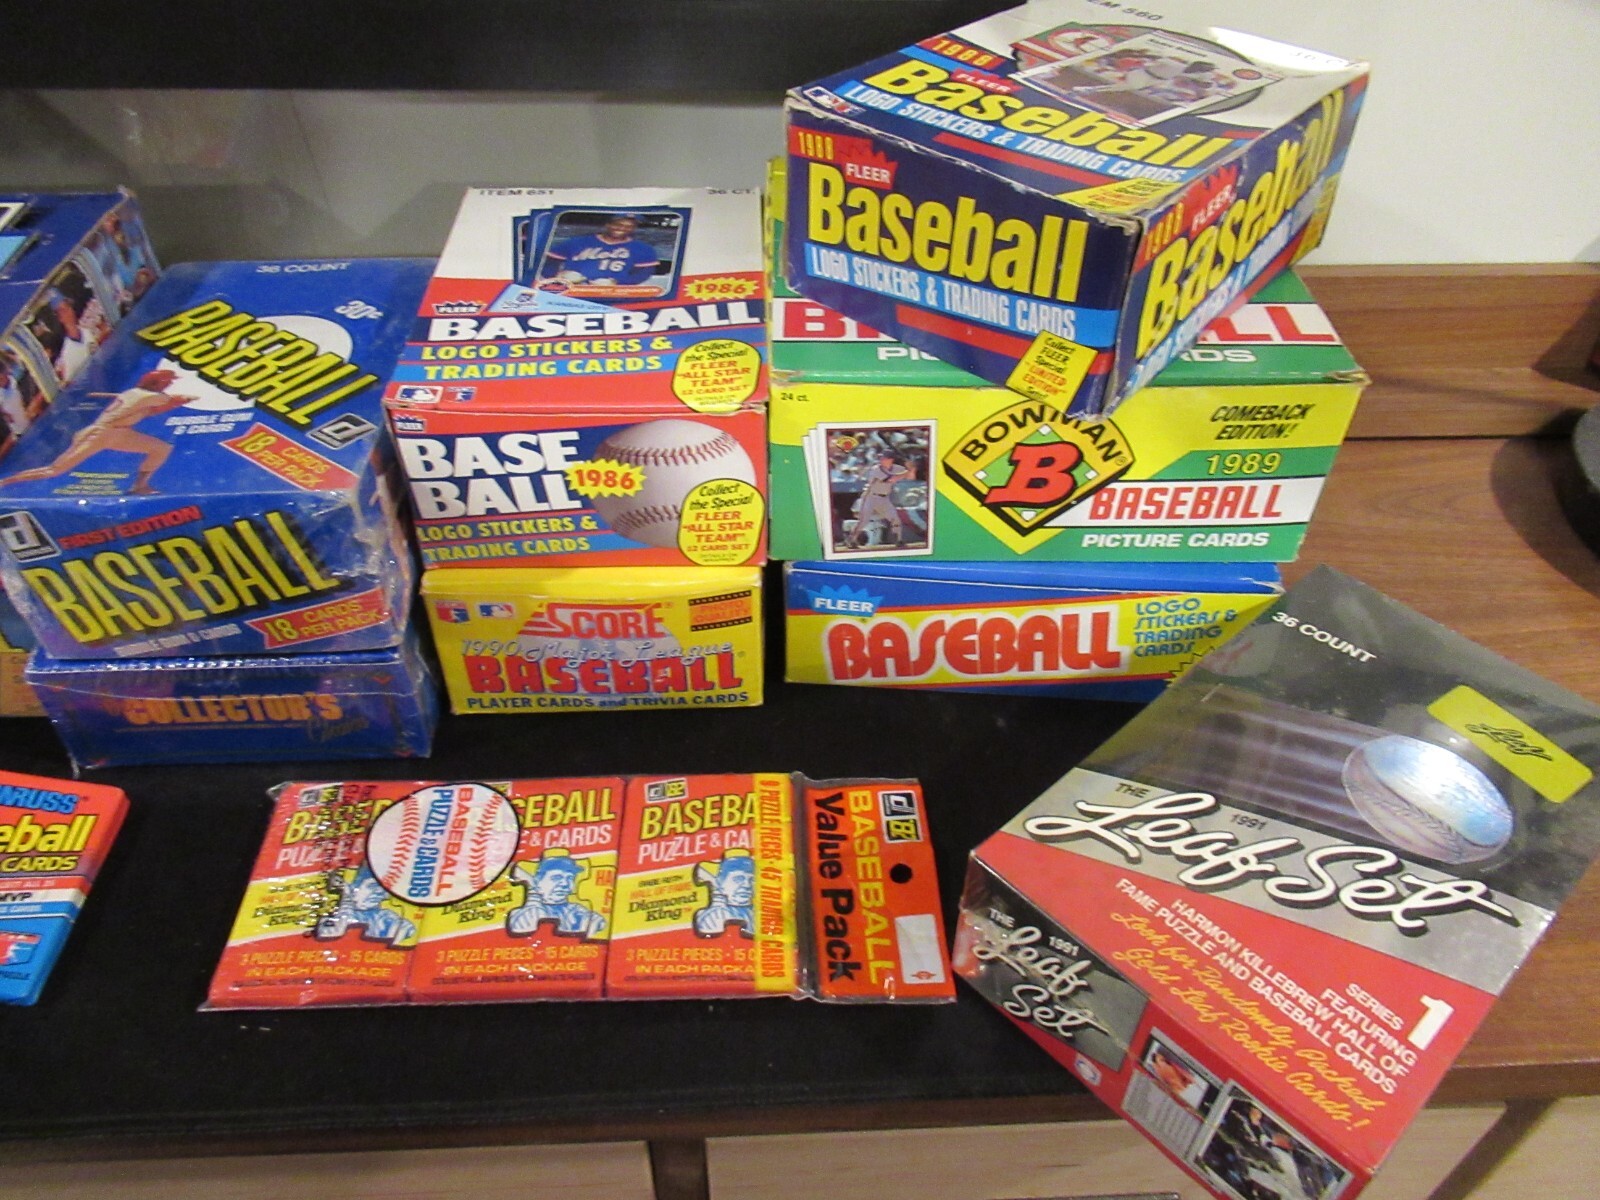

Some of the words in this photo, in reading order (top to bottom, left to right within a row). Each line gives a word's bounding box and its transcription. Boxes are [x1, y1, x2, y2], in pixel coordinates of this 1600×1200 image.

[954, 74, 1011, 92] FLEER
[862, 60, 1233, 168] Baseball
[844, 84, 903, 111] LOGO
[902, 102, 994, 138] STICKERS
[991, 130, 1016, 145] &
[1015, 135, 1107, 170] TRADING
[1107, 157, 1187, 182] CARDS
[846, 163, 891, 183] FLEER
[808, 163, 1089, 302] Baseball
[282, 262, 351, 274] COUNT
[599, 260, 626, 272] 16
[694, 282, 746, 295] 1986
[812, 247, 849, 280] LOGO
[853, 256, 920, 302] STICKERS
[926, 276, 938, 300] &
[943, 283, 1010, 327] TRADING
[1015, 301, 1075, 341] CARDS
[428, 302, 760, 341] BASEBALL
[437, 305, 481, 313] FLEER
[421, 345, 500, 360] LOGO
[516, 340, 646, 358] STICKERS
[650, 336, 673, 350] &
[137, 300, 378, 425] BASEBALL
[424, 362, 557, 380] TRADING
[567, 357, 662, 373] CARDS
[691, 361, 737, 369] FLEER
[714, 368, 750, 376] STAR
[780, 392, 794, 401] 24
[1209, 403, 1315, 422] COMEBACK
[237, 431, 278, 453] 18
[959, 404, 1121, 463] BOWMAN
[1215, 423, 1299, 440] EDITION!
[280, 447, 331, 474] CARDS
[399, 431, 583, 478] BASE
[1206, 453, 1281, 475] 1989
[255, 450, 286, 468] PER
[283, 465, 324, 487] PACK
[574, 469, 635, 489] 1986
[984, 442, 1083, 507] B
[410, 474, 582, 519] BALL
[689, 499, 709, 510] the
[711, 492, 755, 510] Special
[699, 483, 740, 497] Collect
[1088, 485, 1281, 521] BASEBALL
[417, 523, 480, 542] LOGO
[483, 517, 575, 537] STICKERS
[580, 515, 598, 530] &
[695, 511, 741, 521] FLEER
[718, 521, 754, 531] STAR
[425, 544, 518, 562] TRADING
[522, 537, 590, 553] CARDS
[1082, 534, 1184, 548] PICTURE
[1189, 533, 1270, 547] CARDS
[21, 512, 340, 643] BASEBALL
[303, 602, 362, 623] CARDS
[814, 597, 874, 613] FLEER
[1136, 598, 1200, 615] LOGO
[264, 618, 298, 642] 18
[300, 619, 341, 637] PER
[342, 611, 381, 630] PACK
[546, 603, 667, 639] SCORE
[1134, 611, 1220, 629] STICKERS
[1224, 609, 1237, 621] &
[828, 611, 1120, 680] BASEBALL
[1134, 626, 1222, 643] TRADING
[1272, 612, 1299, 628] 36
[1299, 624, 1377, 662] COUNT
[460, 639, 521, 656] 1990
[524, 636, 615, 668] Major
[620, 638, 733, 667] League
[1134, 642, 1195, 657] CARDS
[464, 651, 742, 694] BASEBALL
[125, 692, 344, 724] COLLECTOR'S
[467, 697, 532, 708] PLAYER
[537, 697, 595, 707] CARDS
[599, 696, 627, 707] and
[631, 695, 687, 706] TRIVIA
[693, 692, 748, 704] CARDS
[1113, 783, 1150, 799] THE
[424, 789, 454, 835] PUZZLE
[640, 792, 757, 840] BASEBA
[1230, 813, 1267, 830] 1991
[435, 787, 473, 897] BASEBALL
[530, 833, 541, 846] &
[544, 825, 612, 849] CARDS
[638, 834, 706, 864] PUZZLE
[710, 833, 721, 847] &
[814, 792, 847, 879] Value
[1, 856, 78, 872] CARDS
[408, 846, 439, 898] CARDS
[1023, 793, 1301, 891] Leaf
[1265, 845, 1520, 934] Set
[849, 790, 895, 984] BASEBALL
[628, 892, 697, 913] Diamond
[646, 909, 682, 922] King
[760, 885, 783, 935] TRADING
[990, 908, 1015, 927] THE
[820, 888, 861, 983] Pack
[464, 963, 509, 973] EACH
[511, 962, 588, 972] PACKAGE
[636, 948, 681, 960] PUZZLE
[682, 948, 723, 961] PIECES
[760, 941, 784, 978] CARDS
[973, 926, 1092, 995] Leaf
[655, 965, 698, 973] EACH
[701, 965, 756, 974] PACKA
[1116, 879, 1157, 912] FAME
[1155, 907, 1216, 955] PUZZLE
[1213, 948, 1251, 981] AND
[1248, 975, 1332, 1047] BASEBALL
[1335, 1042, 1399, 1094] CARDS
[1171, 900, 1242, 952] HARMON
[1238, 945, 1335, 1020] KILLEBREW
[1331, 1012, 1374, 1058] HALL
[1379, 1054, 1409, 1077] OF
[1003, 984, 1110, 1038] Set
[1110, 912, 1165, 948] Look
[1159, 937, 1198, 969] for
[1193, 963, 1296, 1048] Randomly
[1296, 1048, 1385, 1111] Packed
[1345, 983, 1404, 1031] SERIES
[1321, 988, 1418, 1064] FEATURING
[1407, 994, 1454, 1051] 1
[1113, 947, 1173, 985] Gold
[1171, 985, 1219, 1023] Leaf
[1220, 1016, 1290, 1073] Rookie
[1287, 1072, 1371, 1130] Cards!
